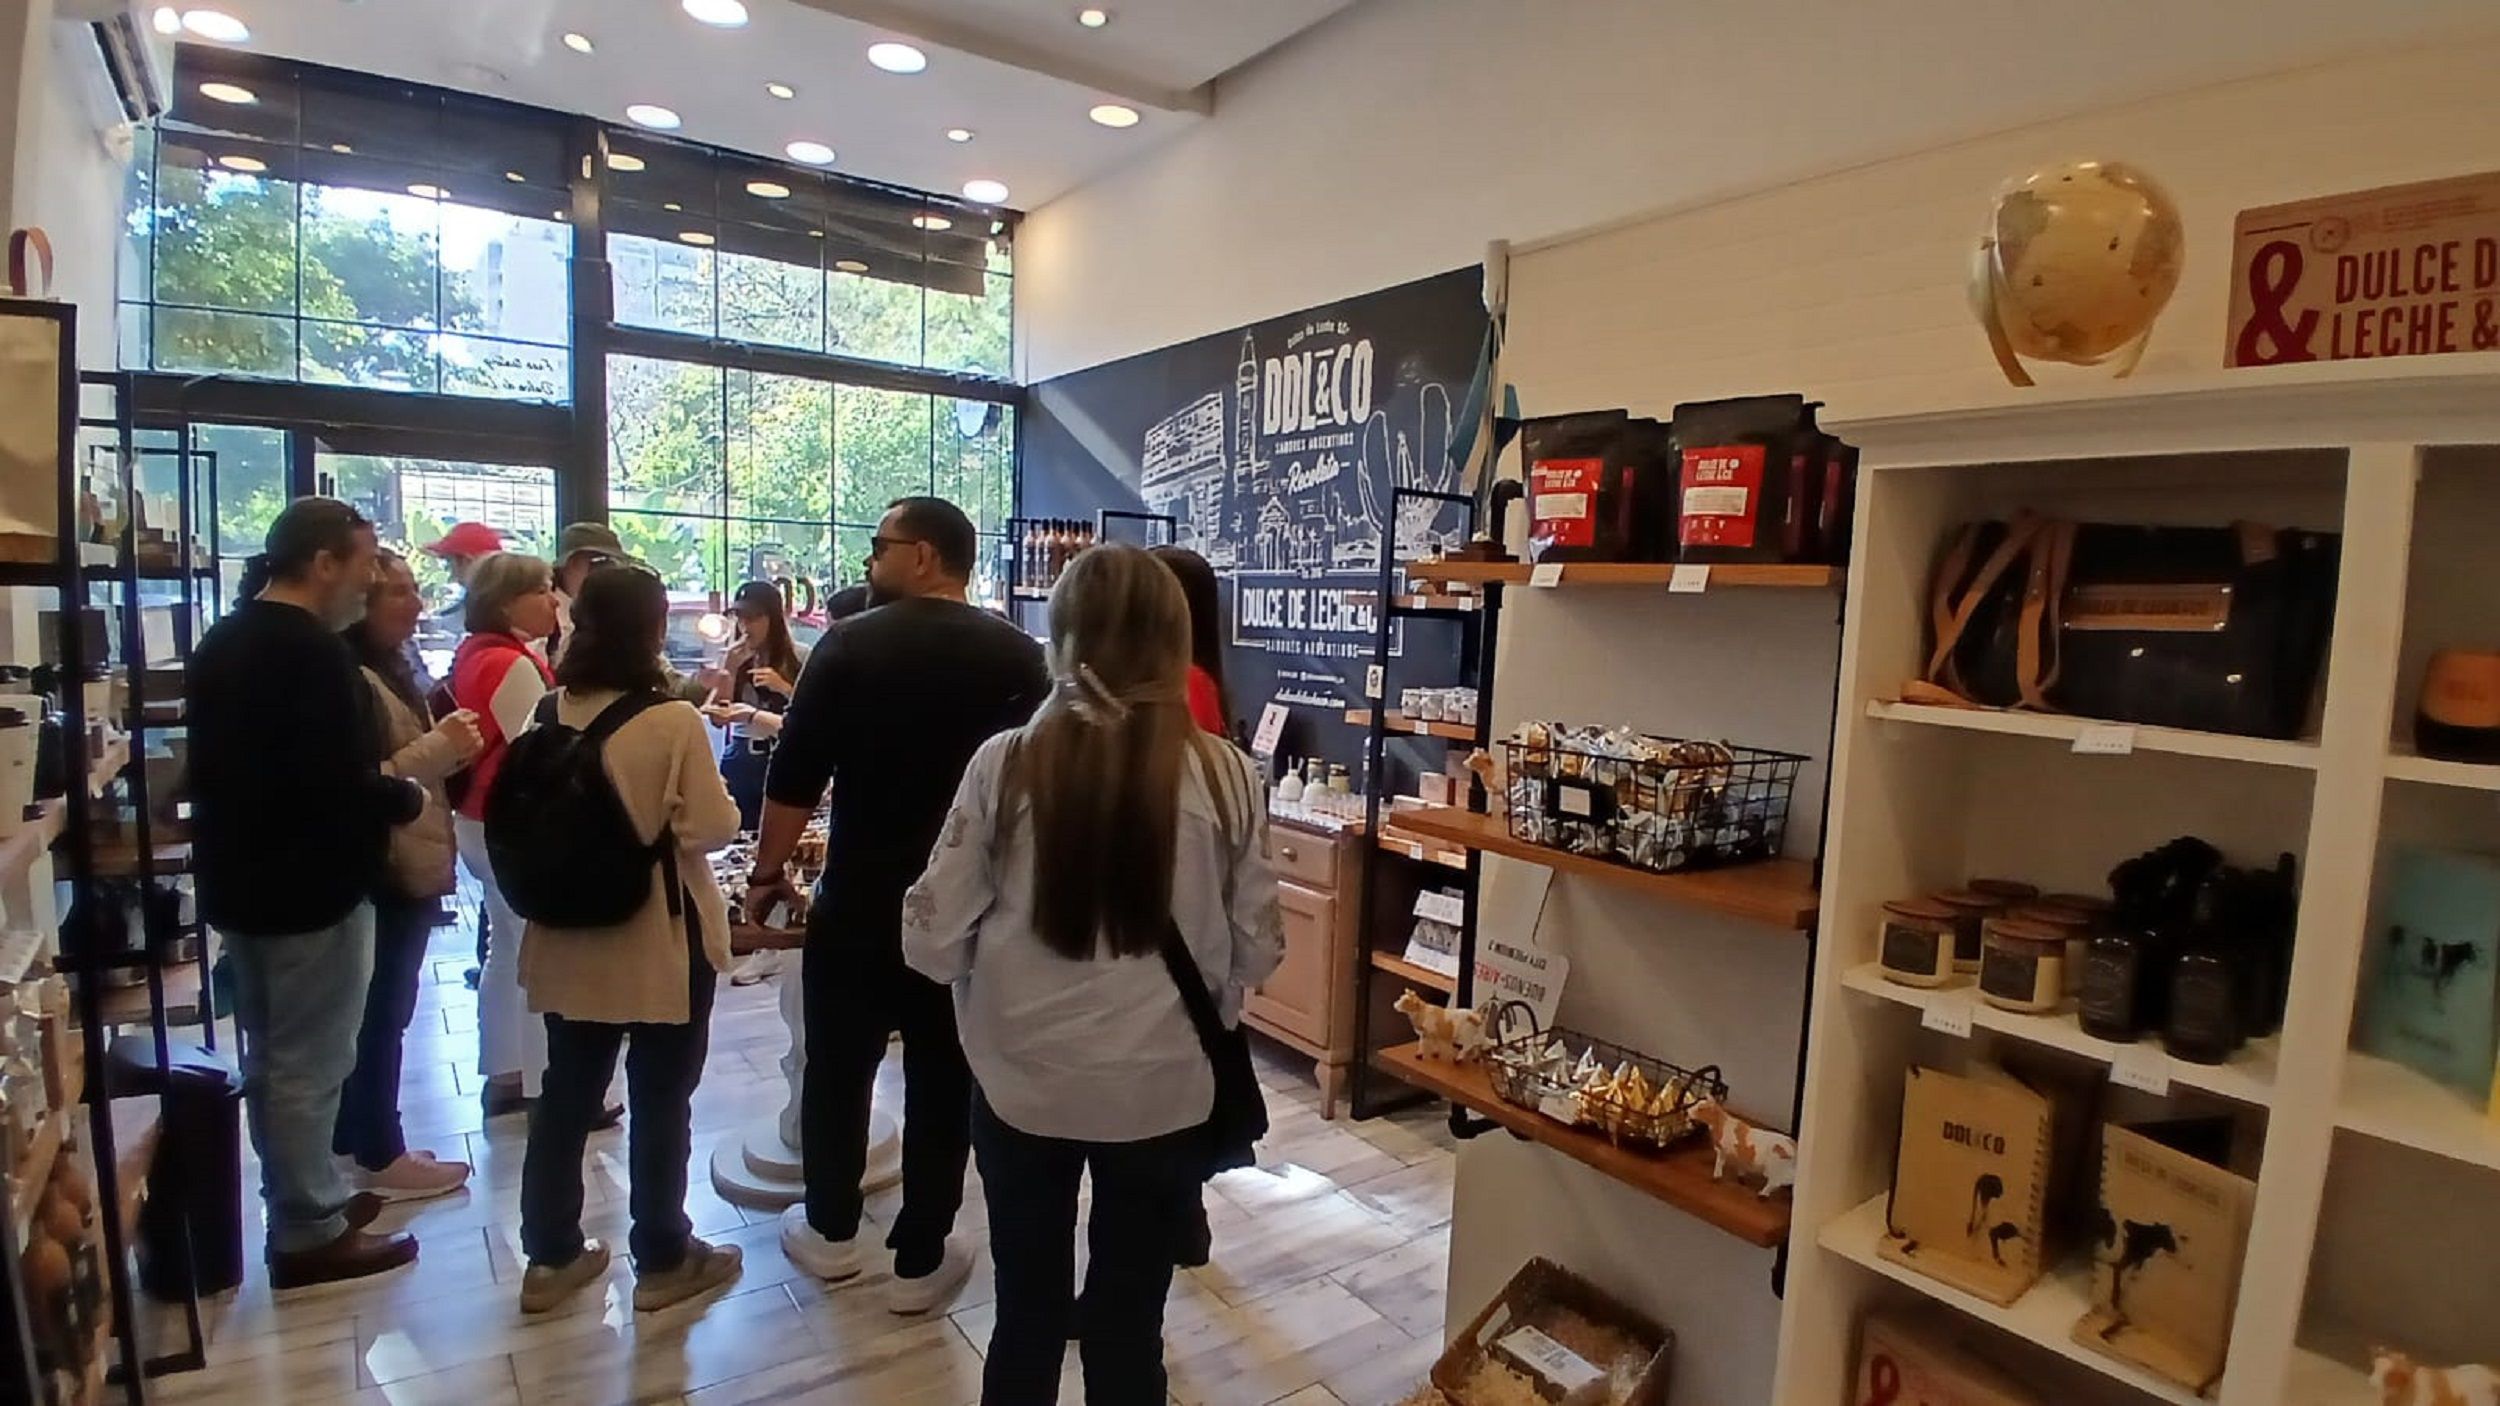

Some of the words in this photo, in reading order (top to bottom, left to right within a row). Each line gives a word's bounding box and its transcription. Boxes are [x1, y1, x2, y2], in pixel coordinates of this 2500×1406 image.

[2336, 242, 2461, 304] DULCE
[2331, 301, 2459, 360] LECHE
[1263, 339, 1375, 436] DDL&CO
[1242, 588, 1284, 627] DULCE
[1288, 588, 1306, 630] DE
